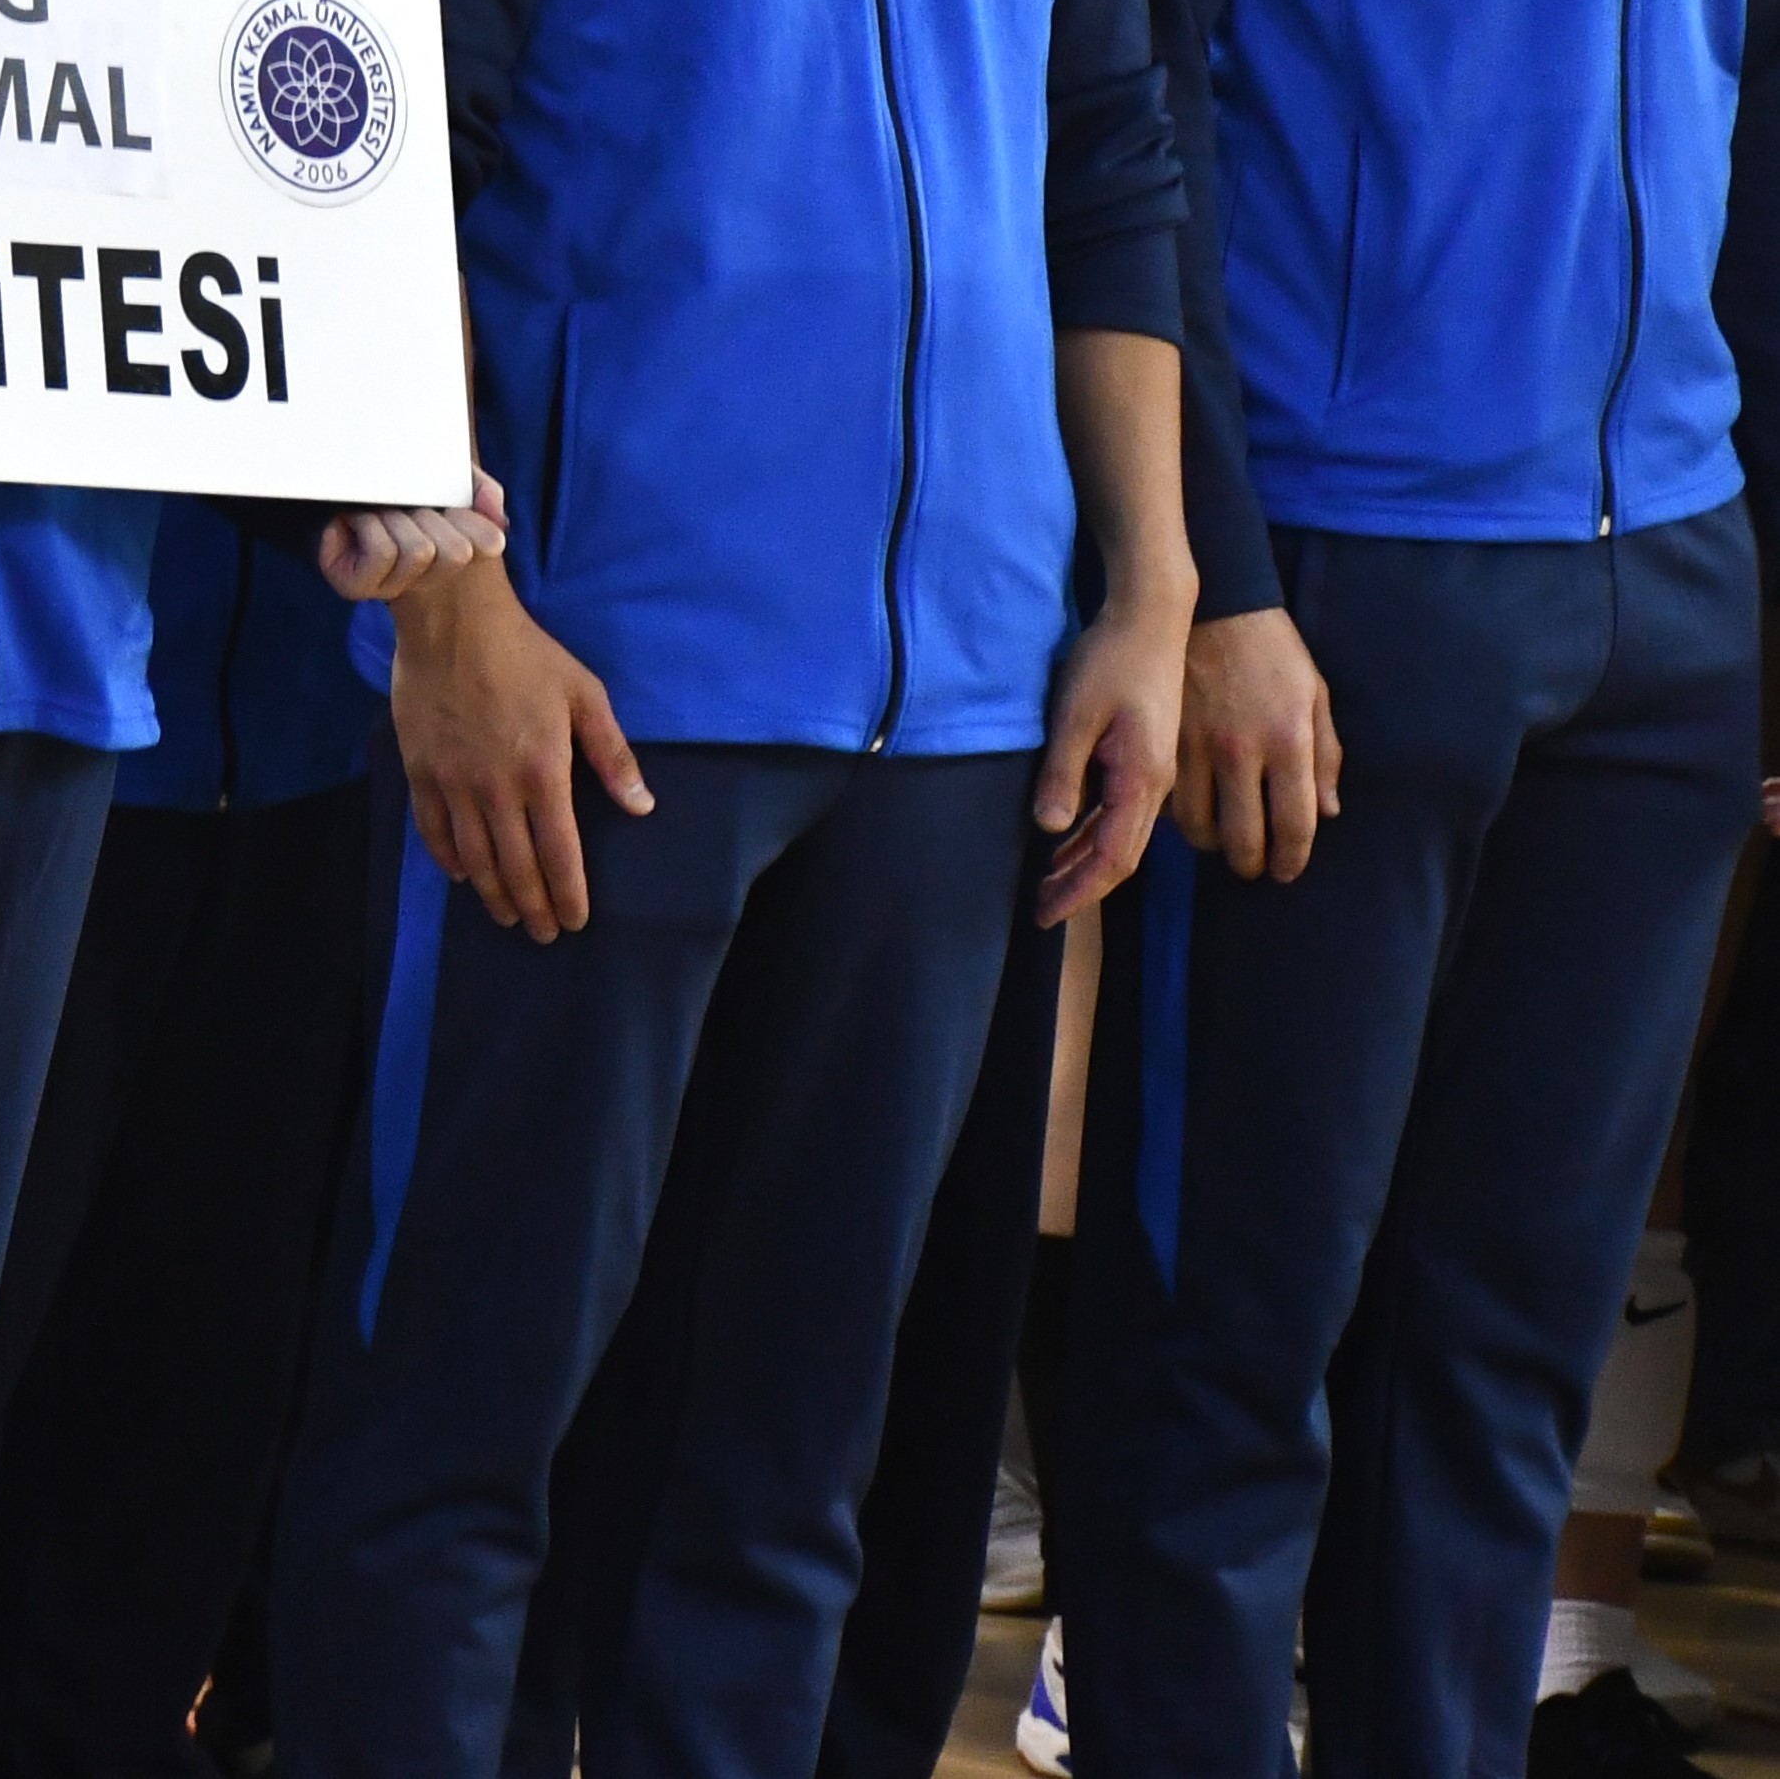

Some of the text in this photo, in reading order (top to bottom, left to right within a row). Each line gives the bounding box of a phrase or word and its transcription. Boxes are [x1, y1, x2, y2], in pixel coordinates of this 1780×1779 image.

[243, 1, 309, 57] KEMAL
[239, 61, 277, 155] NAMIK
[293, 159, 348, 185] 2006
